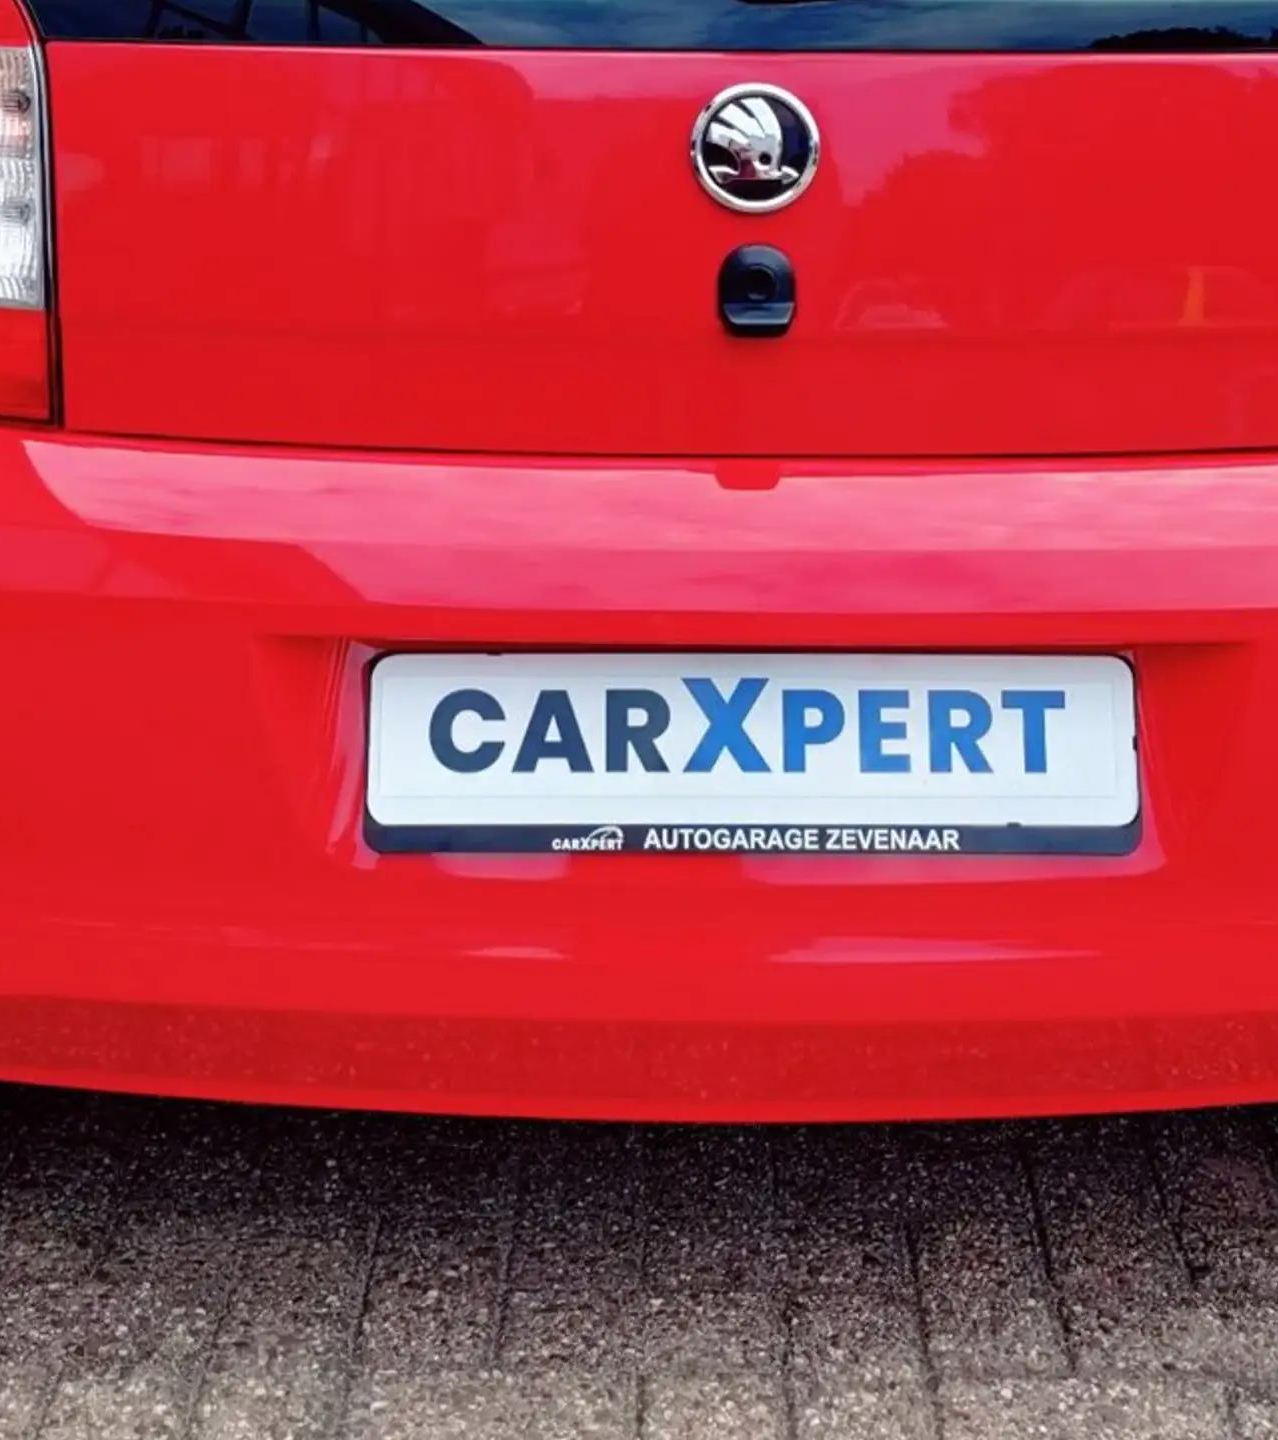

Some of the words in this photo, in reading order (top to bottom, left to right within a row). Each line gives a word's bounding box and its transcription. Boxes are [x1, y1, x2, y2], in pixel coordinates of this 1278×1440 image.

[428, 677, 1066, 774] CARXPERT
[552, 836, 623, 851] CARXPERT
[644, 828, 819, 850] AUTOGARAGE
[826, 828, 960, 850] ZEVENAAR
